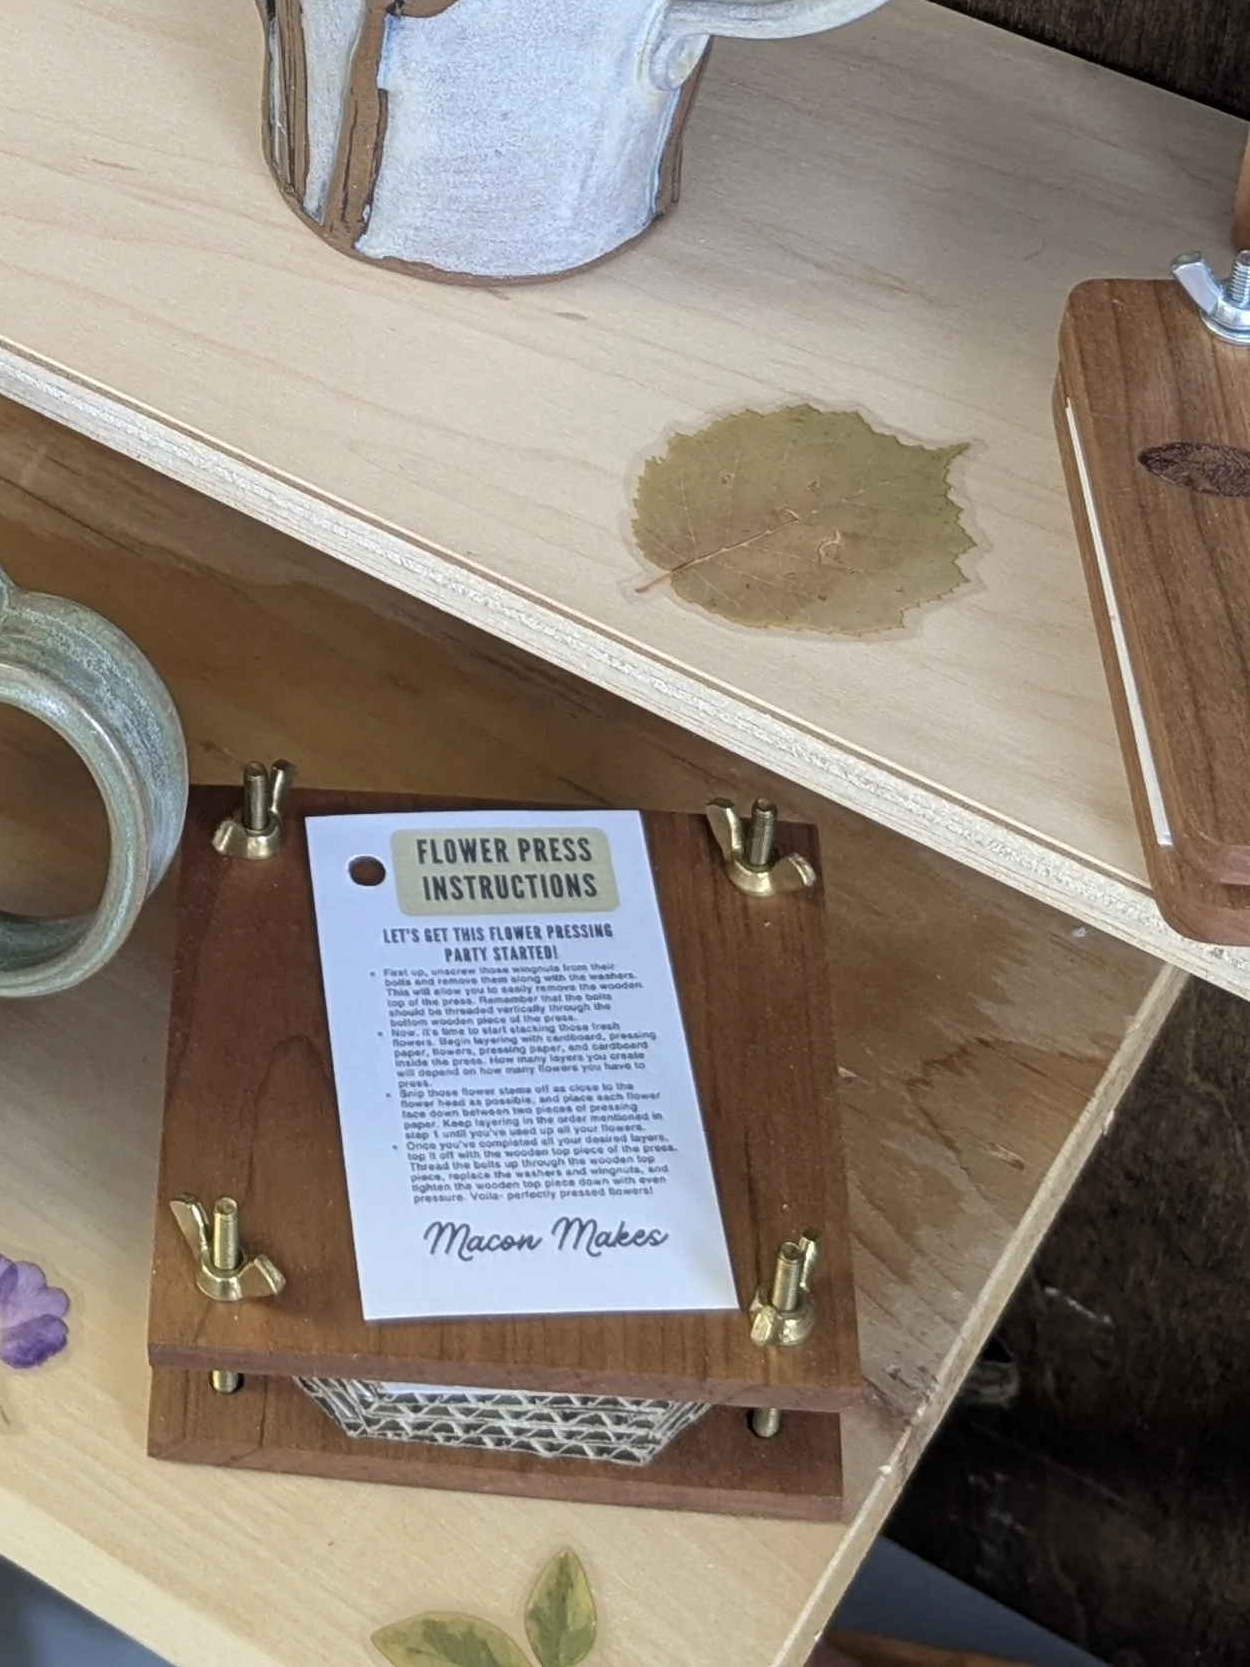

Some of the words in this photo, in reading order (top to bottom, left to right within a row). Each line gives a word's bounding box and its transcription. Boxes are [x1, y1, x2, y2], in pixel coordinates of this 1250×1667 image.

[416, 838, 509, 864] FLOWER
[517, 837, 592, 862] PRESS
[422, 873, 598, 901] INSTRUCTIONS
[382, 928, 420, 944] LET'S
[424, 928, 448, 943] GET
[453, 926, 484, 942] THIS
[489, 925, 541, 941] FLOWER
[547, 923, 613, 938] PRESSING
[444, 947, 487, 962] PARTY
[493, 945, 559, 961] STARTED!
[465, 987, 485, 995] you
[579, 982, 598, 990] the
[523, 1014, 541, 1022] the
[568, 1043, 590, 1051] and
[587, 1053, 608, 1062] you
[582, 1064, 602, 1072] you
[616, 1082, 634, 1090] the
[539, 1095, 561, 1103] and
[536, 1116, 555, 1124] the
[557, 1125, 572, 1133] all
[484, 1149, 502, 1157] the
[621, 1144, 640, 1152] the
[453, 1161, 471, 1169] the
[568, 1156, 587, 1164] the
[494, 1170, 513, 1178] the
[566, 1167, 588, 1175] and
[647, 1164, 669, 1172] and
[424, 1221, 543, 1262] Macon
[551, 1216, 669, 1257] Makes
